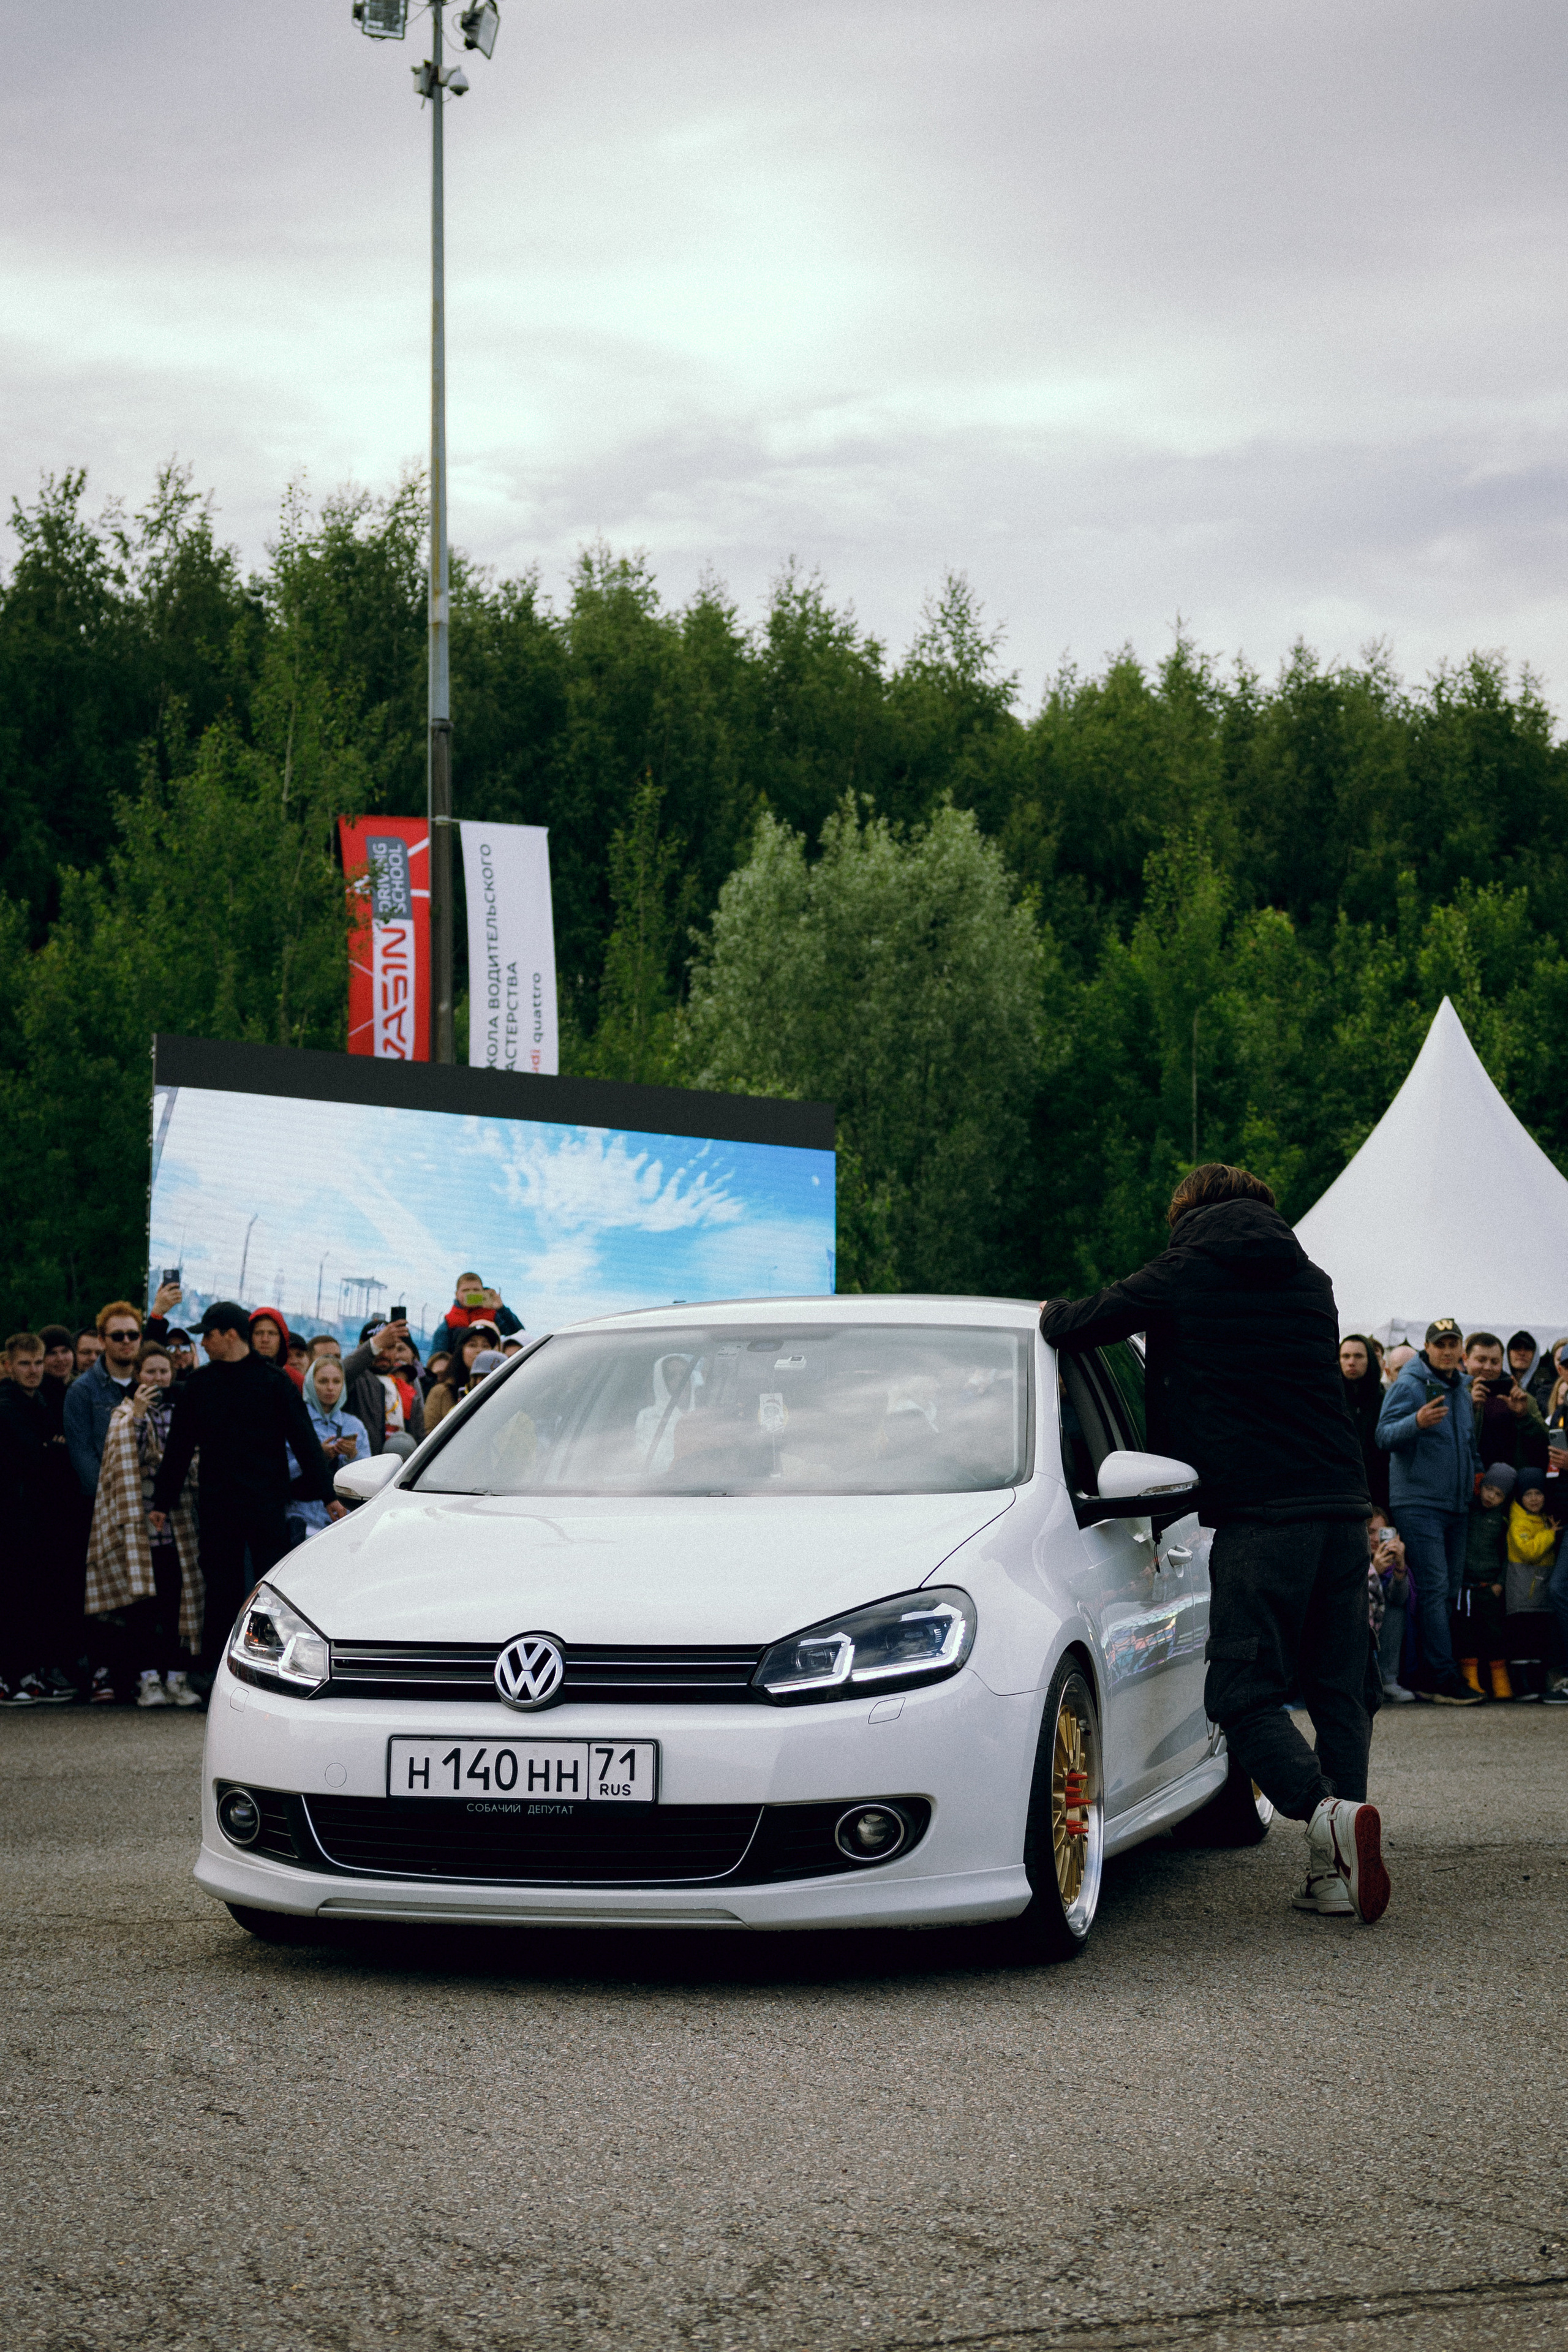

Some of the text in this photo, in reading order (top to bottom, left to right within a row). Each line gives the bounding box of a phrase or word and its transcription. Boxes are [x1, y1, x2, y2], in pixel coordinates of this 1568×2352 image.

[372, 843, 392, 913] DRIVNG
[388, 844, 407, 913] SCHOOL
[480, 843, 502, 1009] ВОДИТЕЛЬСКОГО
[532, 973, 543, 1042] quattro
[1434, 1319, 1453, 1330] W
[595, 1747, 636, 1781] 71
[599, 1783, 631, 1796] RUS
[466, 1803, 574, 1815] СОБАЧИЙ ДЕПУТАТ
